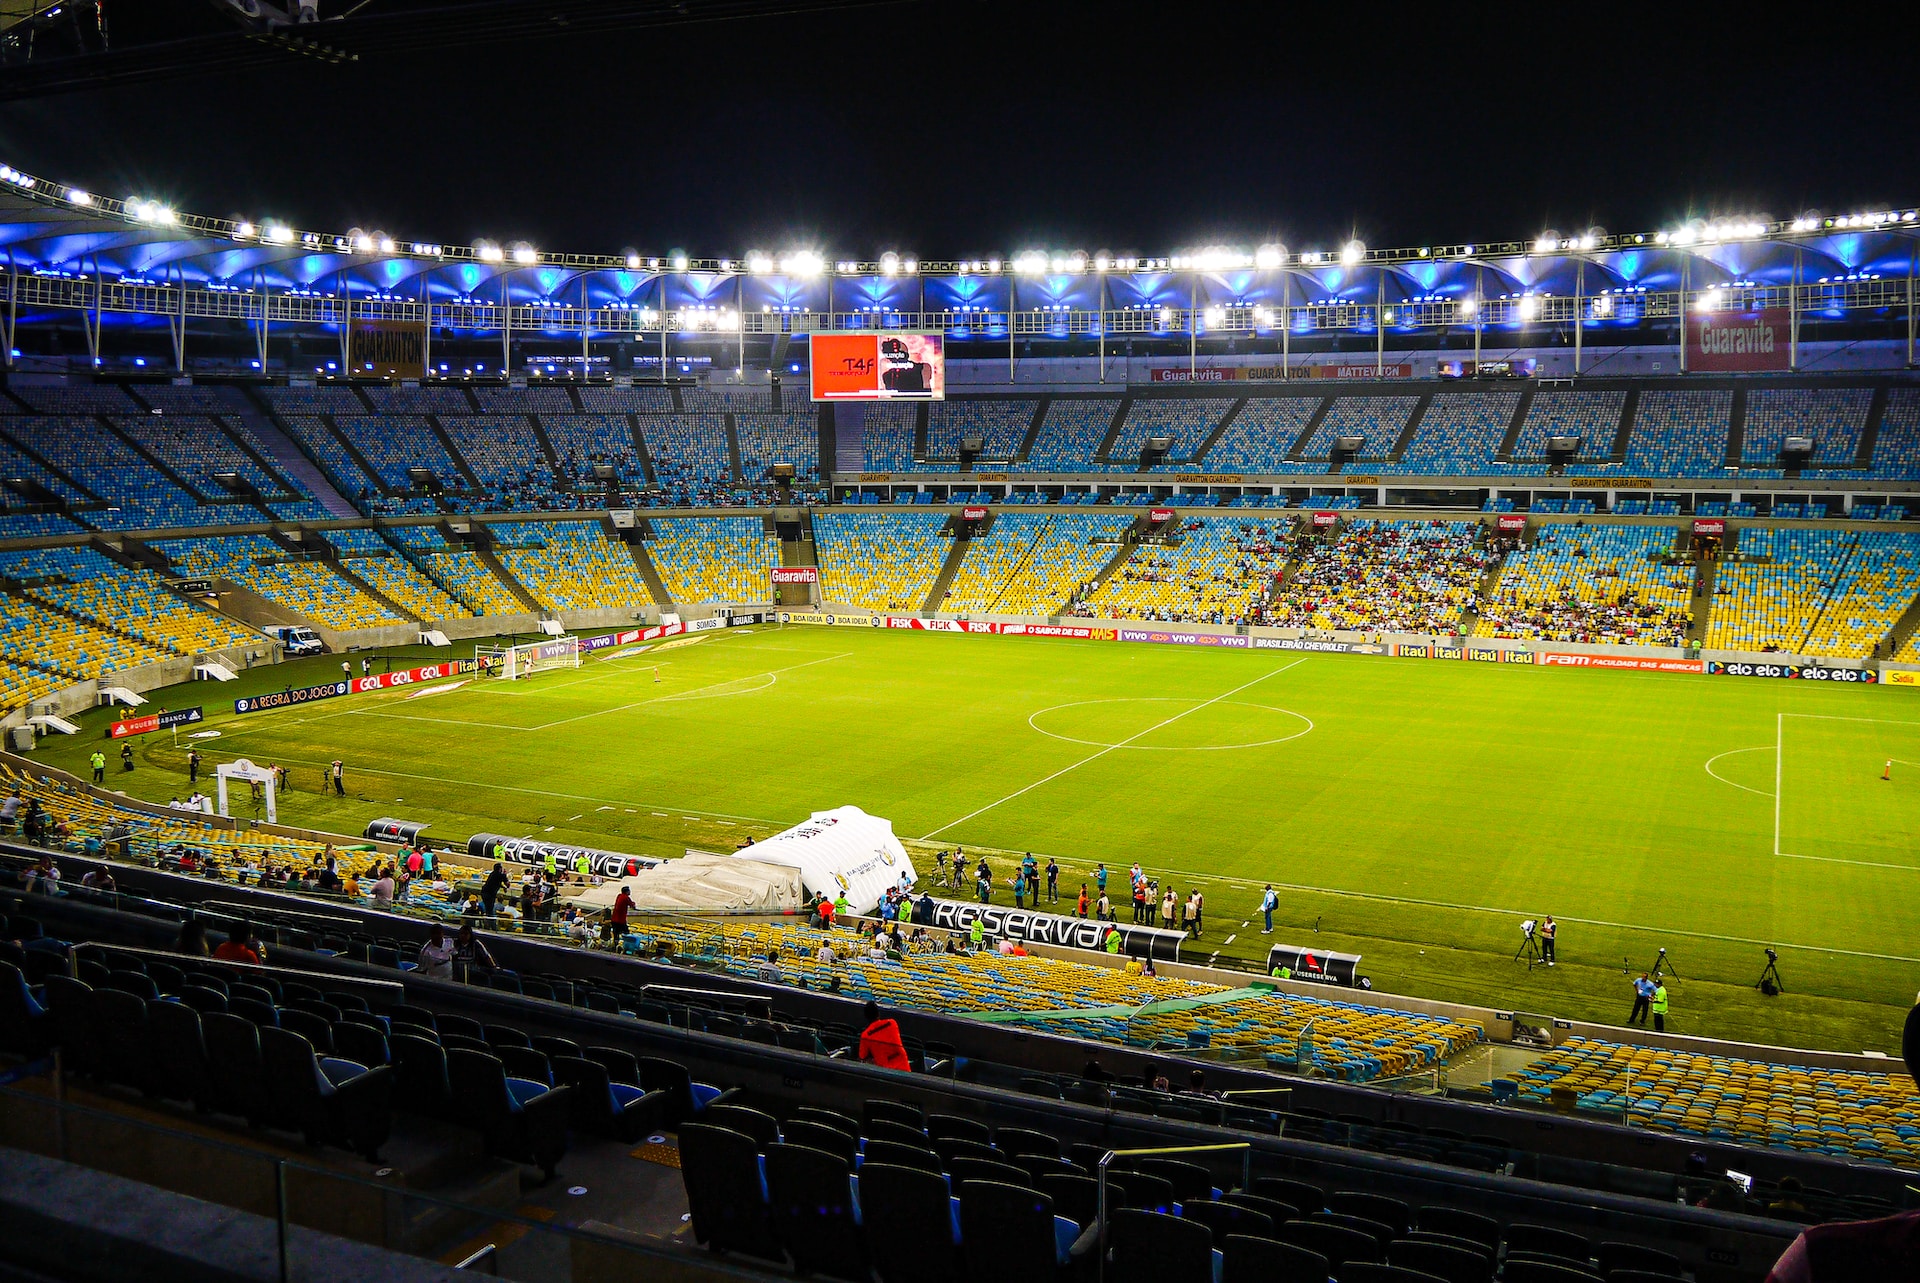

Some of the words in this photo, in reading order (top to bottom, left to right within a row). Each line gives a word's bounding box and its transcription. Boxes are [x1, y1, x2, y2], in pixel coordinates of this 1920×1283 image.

[1699, 318, 1774, 355] Guaravita
[354, 329, 423, 364] GUARAVITON
[1694, 522, 1724, 532] Guaravita
[772, 569, 816, 582] Guaravita
[696, 619, 717, 630] SOMOS
[732, 614, 755, 626] IGUAIS
[891, 618, 913, 628] FISK
[930, 620, 950, 630] FISK
[968, 622, 992, 633] FISK
[1034, 627, 1061, 635] SABOR
[1062, 628, 1072, 636] DE
[1073, 629, 1090, 637] SER
[1090, 628, 1115, 640] MAIS
[1256, 638, 1303, 650] BRASILEIRÃO
[1304, 640, 1348, 652] CHEVROLET
[1399, 645, 1426, 658] Itaú
[1434, 646, 1461, 660] Itaú
[1469, 647, 1496, 662] Itaú
[1505, 649, 1533, 664] Itaú
[1592, 659, 1638, 668] FACULDADE
[1640, 661, 1657, 669] DAS
[391, 671, 414, 685] GOL
[420, 666, 442, 680] GOL
[1892, 673, 1914, 684] Sadia
[360, 676, 384, 691] GOL
[250, 699, 259, 710] A
[260, 693, 290, 708] REGRA
[292, 691, 307, 702] DO
[307, 684, 336, 699] JOGO
